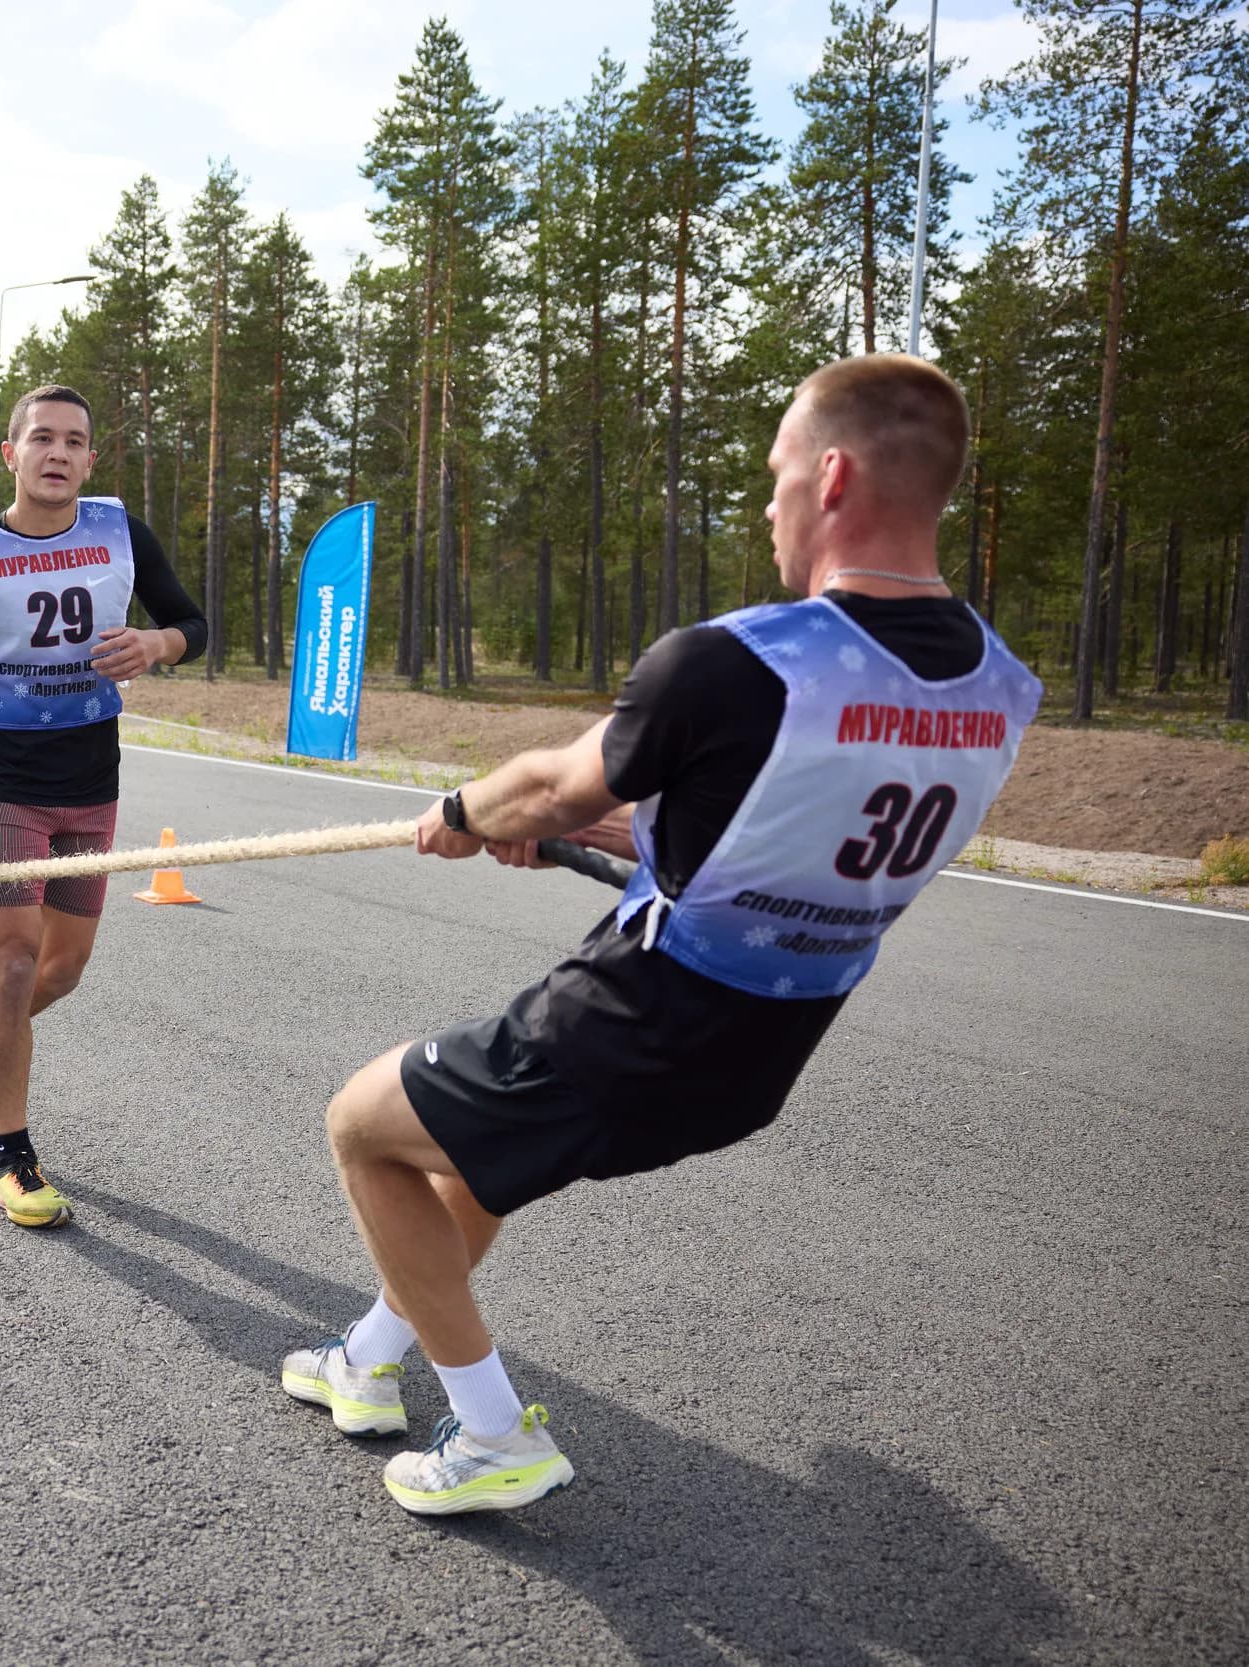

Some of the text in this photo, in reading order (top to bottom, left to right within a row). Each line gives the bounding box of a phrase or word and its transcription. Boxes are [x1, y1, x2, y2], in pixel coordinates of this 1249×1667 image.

[27, 586, 93, 648] 29
[310, 585, 334, 714] Ямальский
[327, 606, 356, 717] Характер
[837, 704, 1006, 749] МУРАВЛЕНКО
[834, 781, 958, 881] 30
